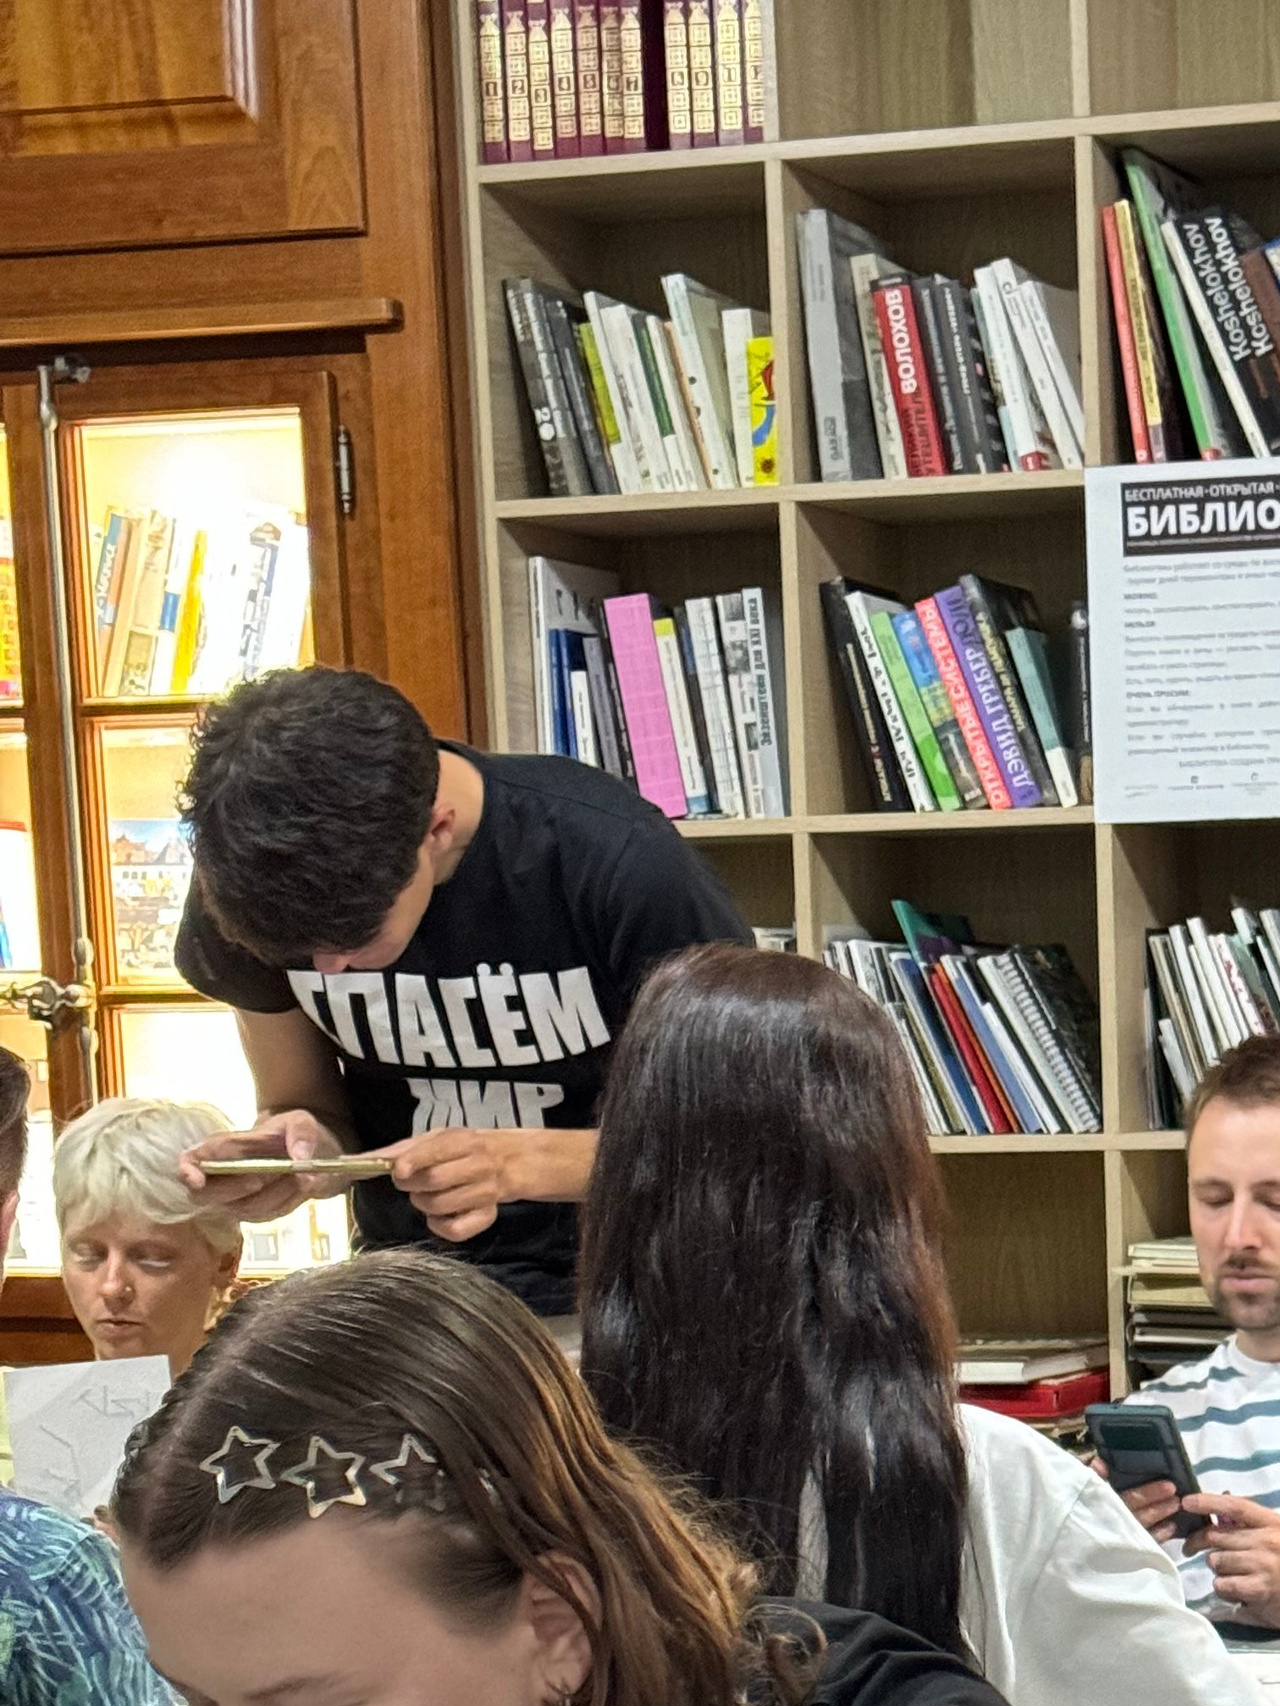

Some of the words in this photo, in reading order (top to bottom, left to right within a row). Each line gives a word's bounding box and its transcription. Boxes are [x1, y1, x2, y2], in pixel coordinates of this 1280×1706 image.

[1182, 220, 1252, 361] Koshelokhov
[1205, 215, 1274, 357] Koshelokhov
[885, 289, 919, 394] ВОЛОХОВ
[1124, 488, 1204, 503] БЕСПЛАТНАЯ
[1209, 481, 1274, 498] ОТКРЫТАЯ
[920, 604, 967, 700] СИСТЕМЫ
[969, 645, 1004, 714] ГРЕБЕР
[959, 697, 1006, 804] ОТКРЫТЫЕ
[992, 718, 1031, 790] ДЭВИД
